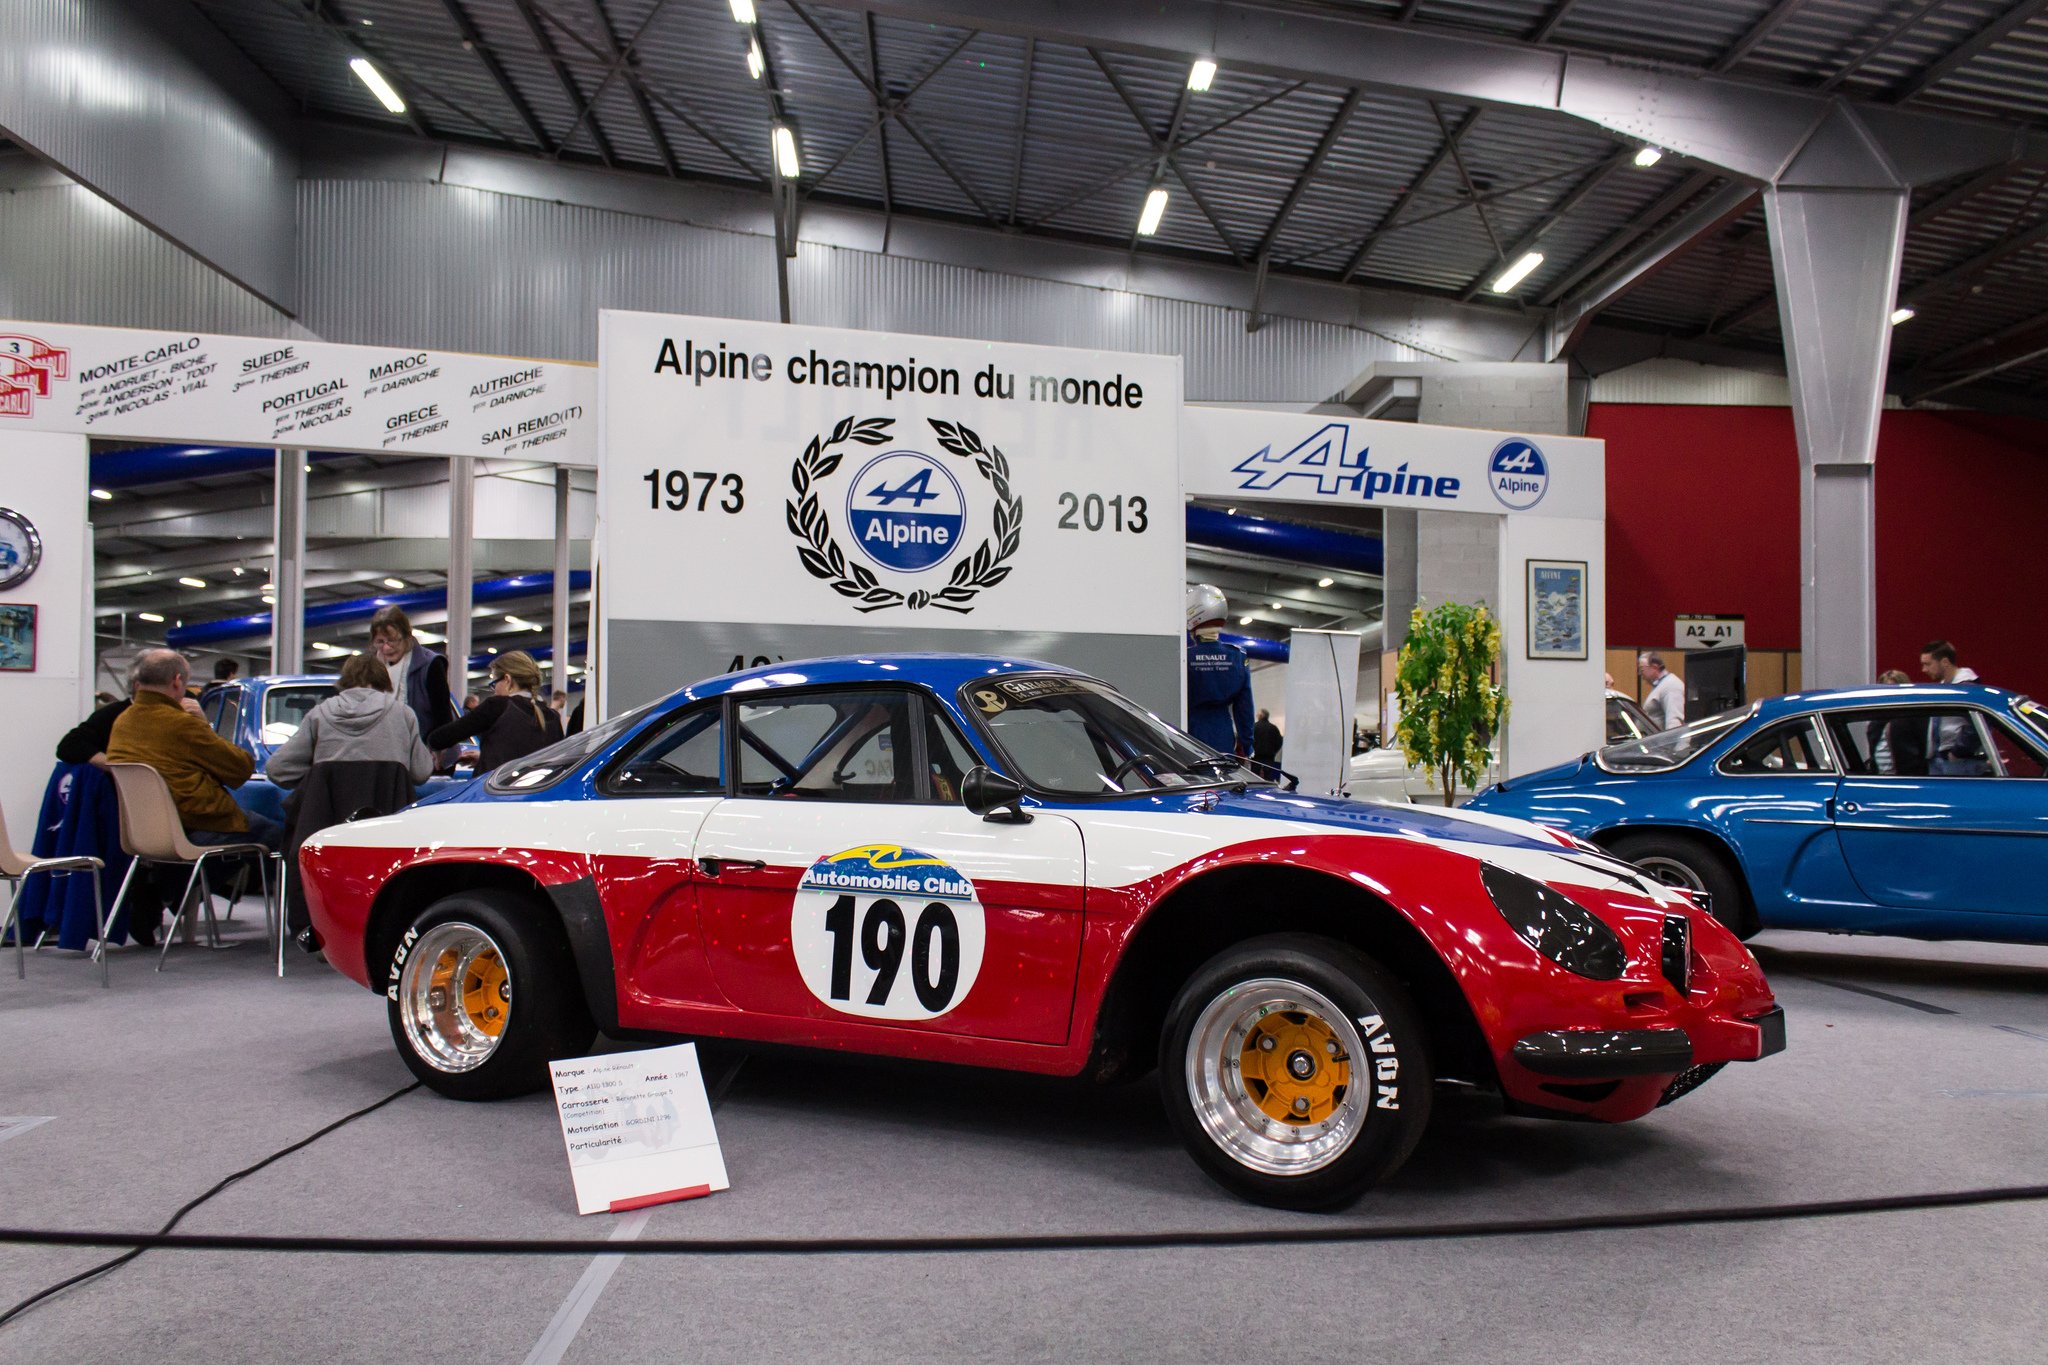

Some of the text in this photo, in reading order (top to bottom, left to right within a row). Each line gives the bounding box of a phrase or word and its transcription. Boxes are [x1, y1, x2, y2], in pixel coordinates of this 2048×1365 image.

[80, 337, 200, 384] MONTE-CARLO
[242, 346, 294, 372] SUEDE
[369, 353, 427, 380] MAROC
[99, 369, 159, 395] ANDRUET
[170, 354, 208, 374] BICHE
[260, 361, 310, 384] THERIER
[381, 367, 441, 393] DARNICHE
[470, 366, 544, 398] AUTRICHE
[654, 338, 1143, 409] Alpine champion du monde
[104, 377, 174, 406] ANDERSON
[114, 391, 170, 416] NICOLAS
[181, 379, 208, 394] VIAL
[263, 377, 349, 413] PORTUGAL
[489, 383, 547, 408] DARNICHE
[295, 397, 344, 420] THERIER
[299, 406, 352, 431] NICOLAS
[386, 404, 438, 429] GRECE
[401, 420, 449, 442] THERIER
[481, 405, 583, 445] SAN REMO(IT)
[521, 428, 567, 450] THERIER
[1230, 423, 1461, 500] Alpine
[643, 468, 745, 514] 1973
[1498, 477, 1539, 494] Alpine
[1057, 491, 1148, 534] 2013
[865, 518, 949, 549] Alpine
[1686, 625, 1732, 637] A2 A1
[801, 869, 973, 896] Automobile Club
[387, 926, 419, 1002] AVON
[825, 894, 960, 1013] 190
[555, 1068, 585, 1078] Marque
[1357, 1014, 1400, 1111] AVON
[558, 1086, 579, 1095] Type
[645, 1073, 668, 1082] Année
[561, 1097, 609, 1110] Carrosserie
[567, 1121, 619, 1134] Motorisation
[570, 1136, 622, 1150] Particularité
